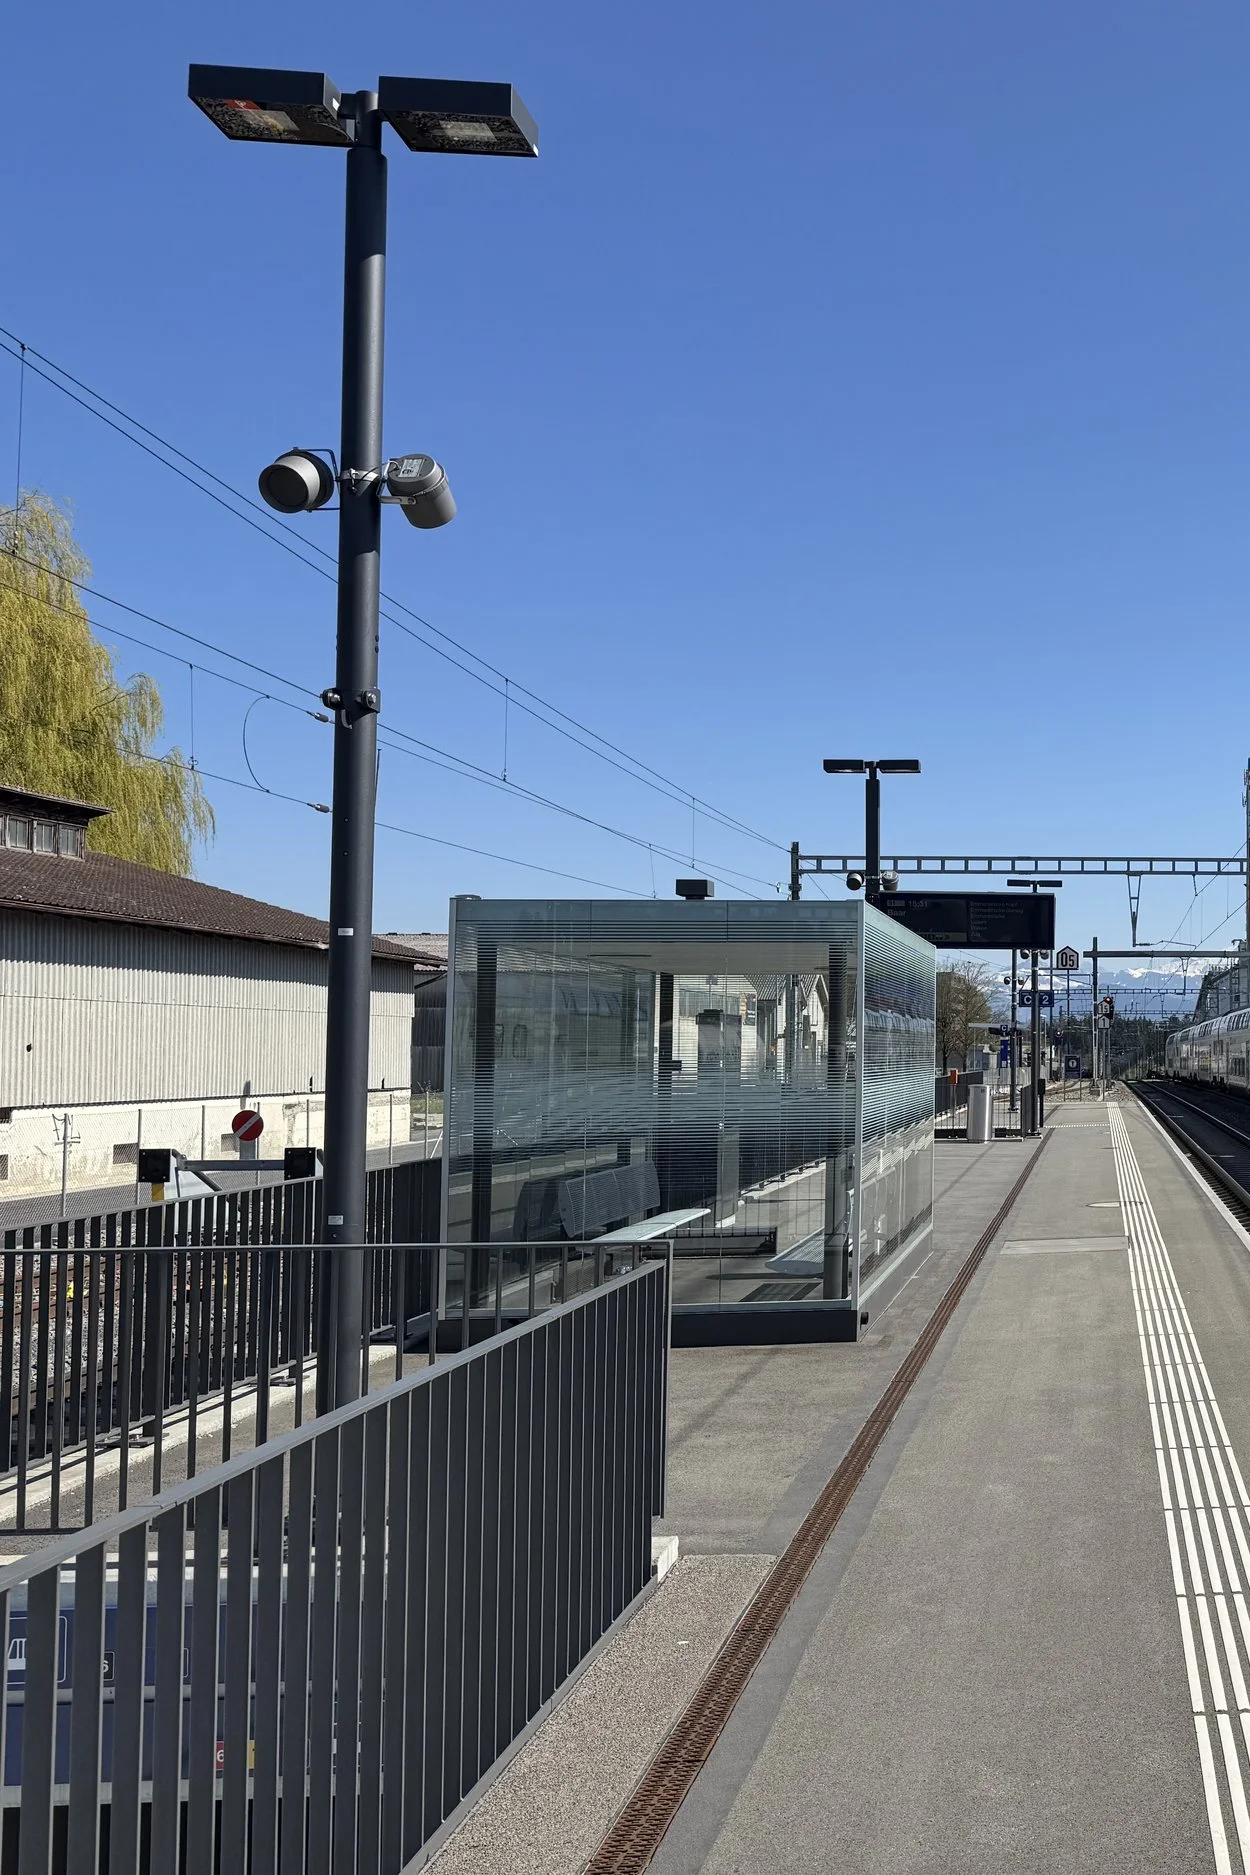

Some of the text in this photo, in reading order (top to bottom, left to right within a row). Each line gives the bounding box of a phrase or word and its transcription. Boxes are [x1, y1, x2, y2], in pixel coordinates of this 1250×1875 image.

[887, 909, 907, 917] Baar
[1061, 951, 1074, 967] 05
[1023, 995, 1031, 1004] C
[1042, 995, 1049, 1004] 2
